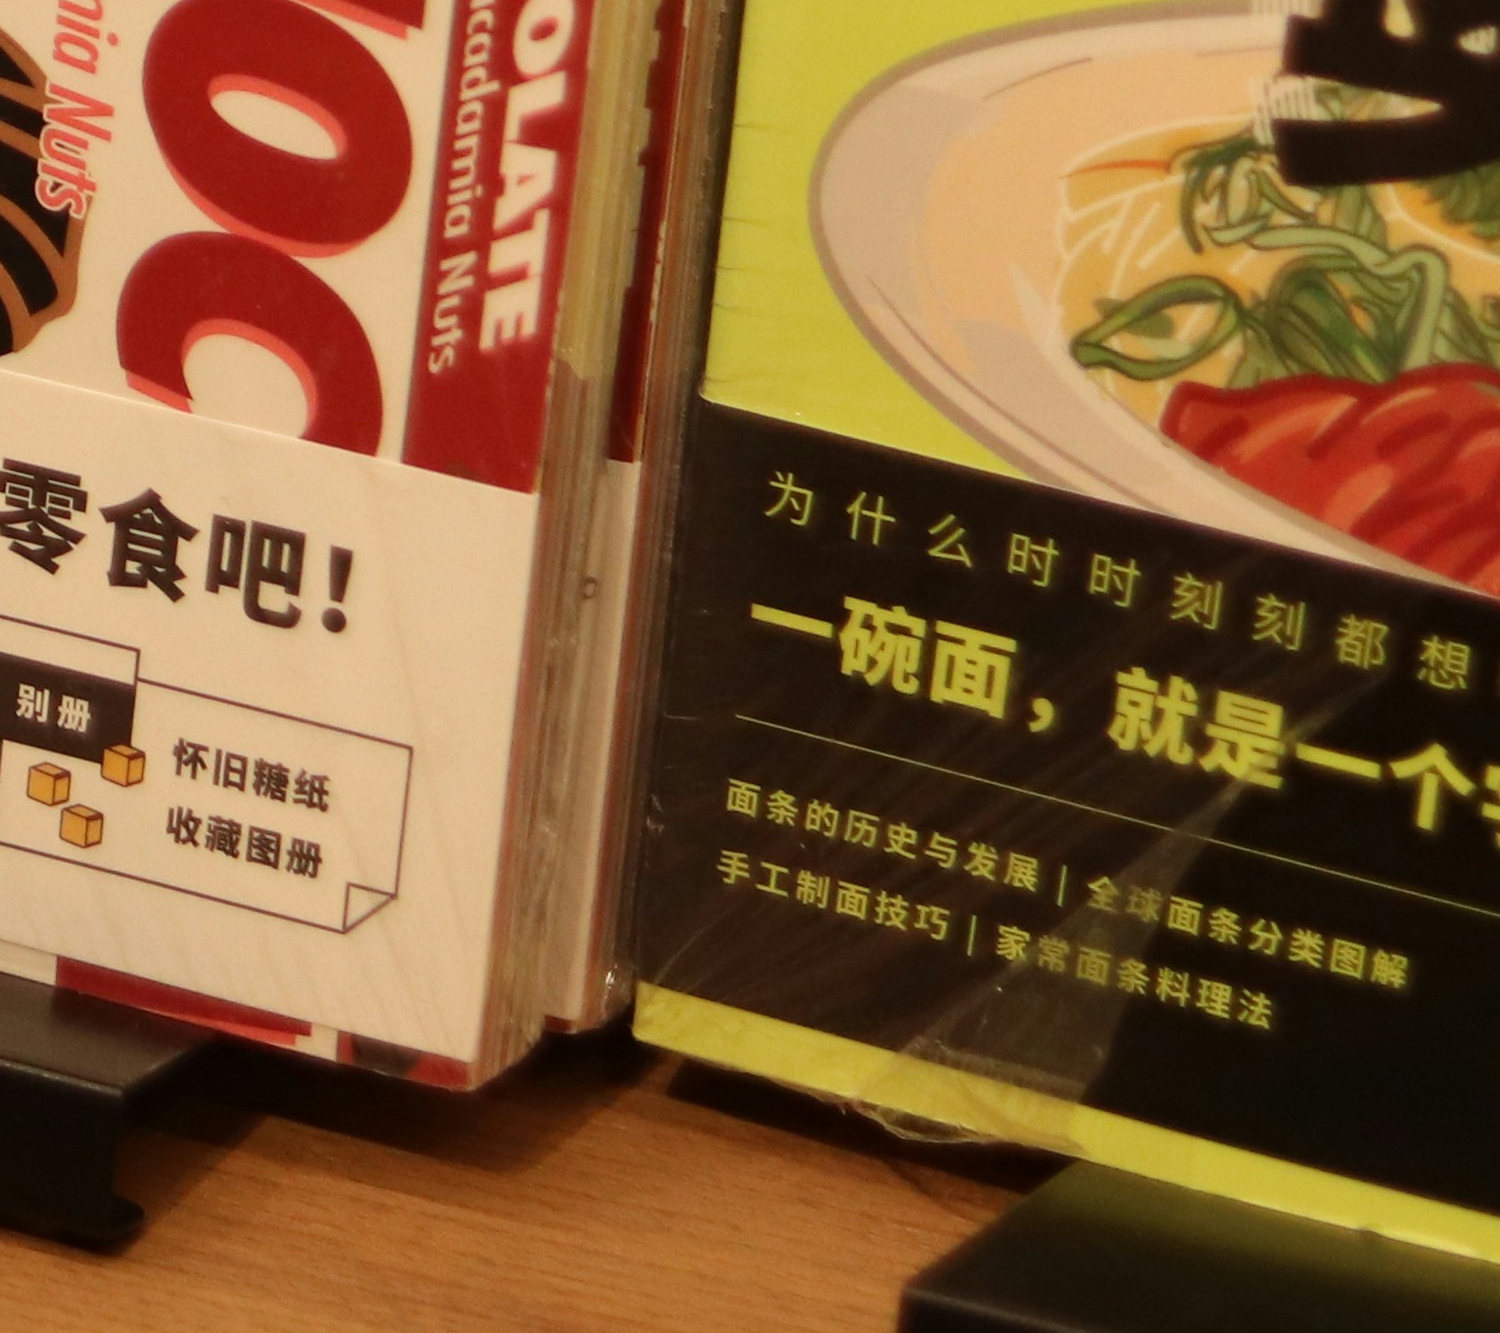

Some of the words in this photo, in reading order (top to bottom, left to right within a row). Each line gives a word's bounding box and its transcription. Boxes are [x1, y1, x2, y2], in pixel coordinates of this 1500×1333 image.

[36, 82, 115, 220] Nuts
[429, 250, 475, 376] Nuts
[16, 683, 92, 734] 别册
[172, 737, 331, 815] 怀旧糖纸
[166, 804, 324, 880] 收藏图册
[725, 777, 1040, 893] 面条的历史与发展
[1087, 874, 1411, 989] 全球面条分类图解
[715, 850, 950, 941] 手工制面技巧
[995, 924, 1276, 1031] 家常面条料理法
